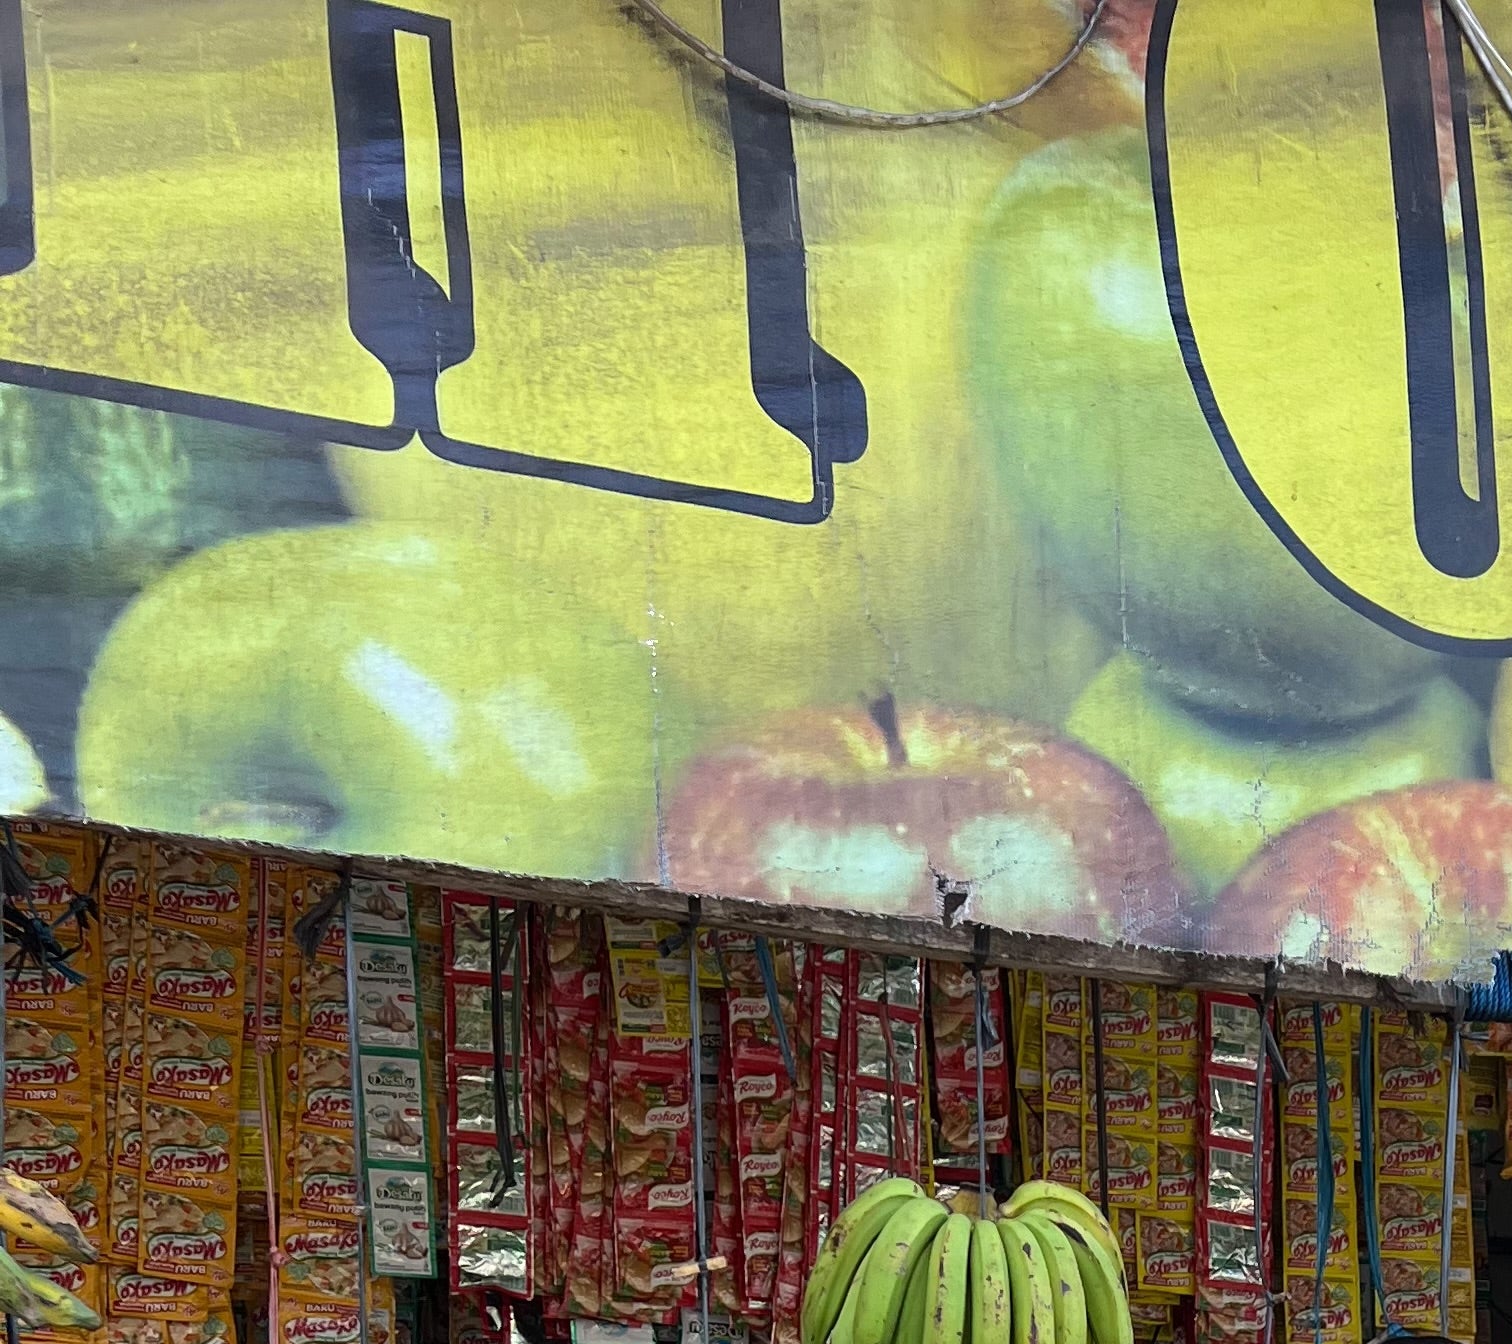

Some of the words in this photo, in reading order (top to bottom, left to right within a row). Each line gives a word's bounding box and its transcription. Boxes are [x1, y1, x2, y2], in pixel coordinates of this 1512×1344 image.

[186, 915, 217, 925] BARU
[160, 977, 235, 997] Masako
[182, 1002, 213, 1012] BARU
[733, 1003, 767, 1014] Royco
[157, 1065, 232, 1086] Masako
[1386, 1068, 1441, 1091] Masako
[739, 1081, 774, 1093] Royco
[25, 1089, 57, 1099] BARU
[180, 1090, 210, 1100] BARU
[649, 1110, 686, 1124] Royco
[1386, 1144, 1442, 1166] Masako
[154, 1153, 229, 1174] Masako
[744, 1160, 778, 1172] Royco
[651, 1188, 689, 1201] Royco
[1386, 1218, 1442, 1240] Masako
[151, 1241, 226, 1261] Masako
[175, 1265, 206, 1275] BARU
[146, 1303, 176, 1312] BARU
[1386, 1293, 1440, 1315] Masako
[285, 1315, 358, 1338] Masako
